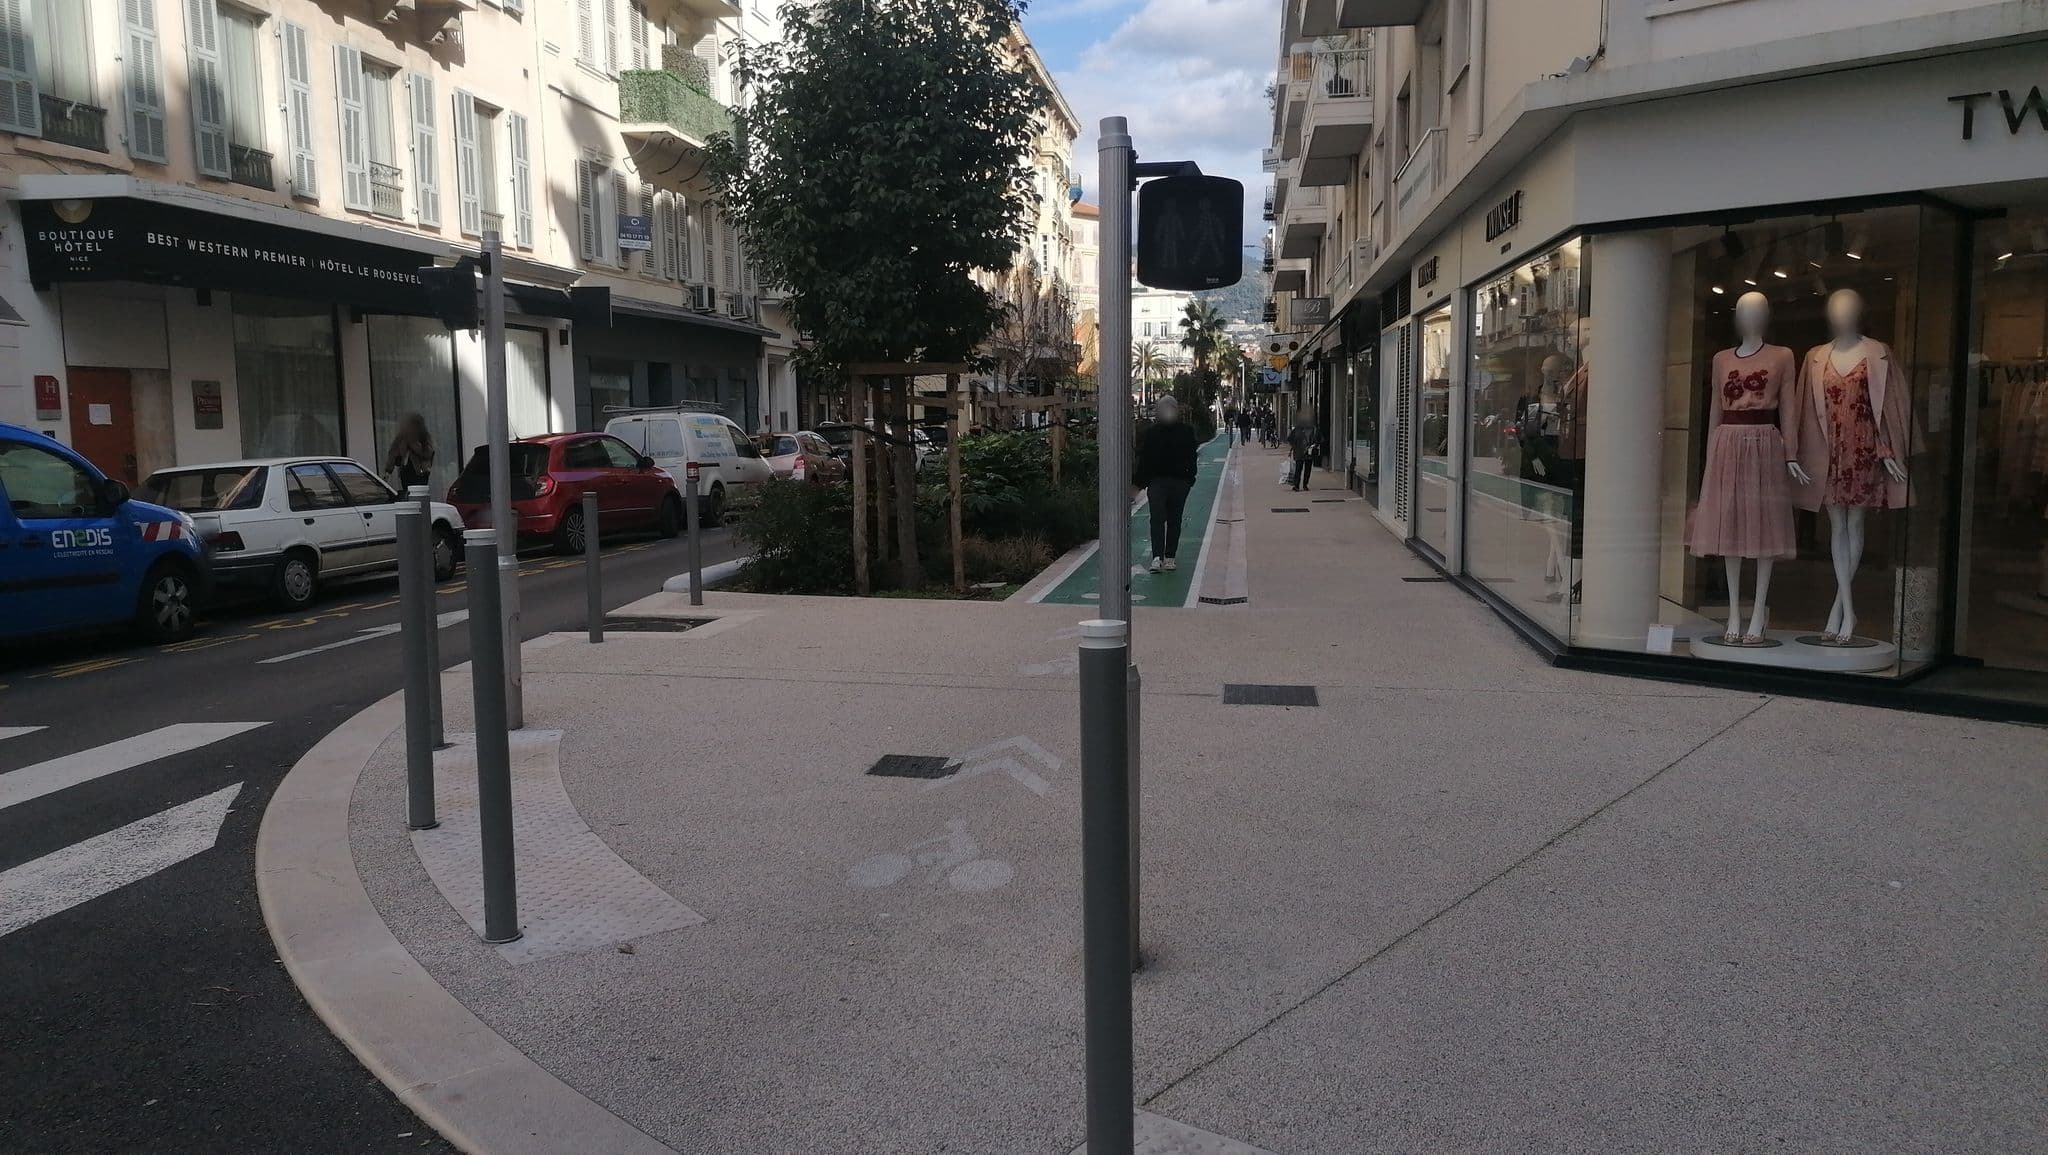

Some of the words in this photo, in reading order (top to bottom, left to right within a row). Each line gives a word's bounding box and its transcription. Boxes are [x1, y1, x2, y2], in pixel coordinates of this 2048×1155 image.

[39, 230, 114, 241] BOUTIQUE
[55, 241, 102, 252] HÔTEL
[147, 232, 179, 247] BEST
[187, 239, 248, 258] WESTERN
[254, 249, 306, 267] PREMIER
[319, 259, 354, 274] HÔTEL
[358, 266, 369, 276] LE
[45, 381, 56, 394] H
